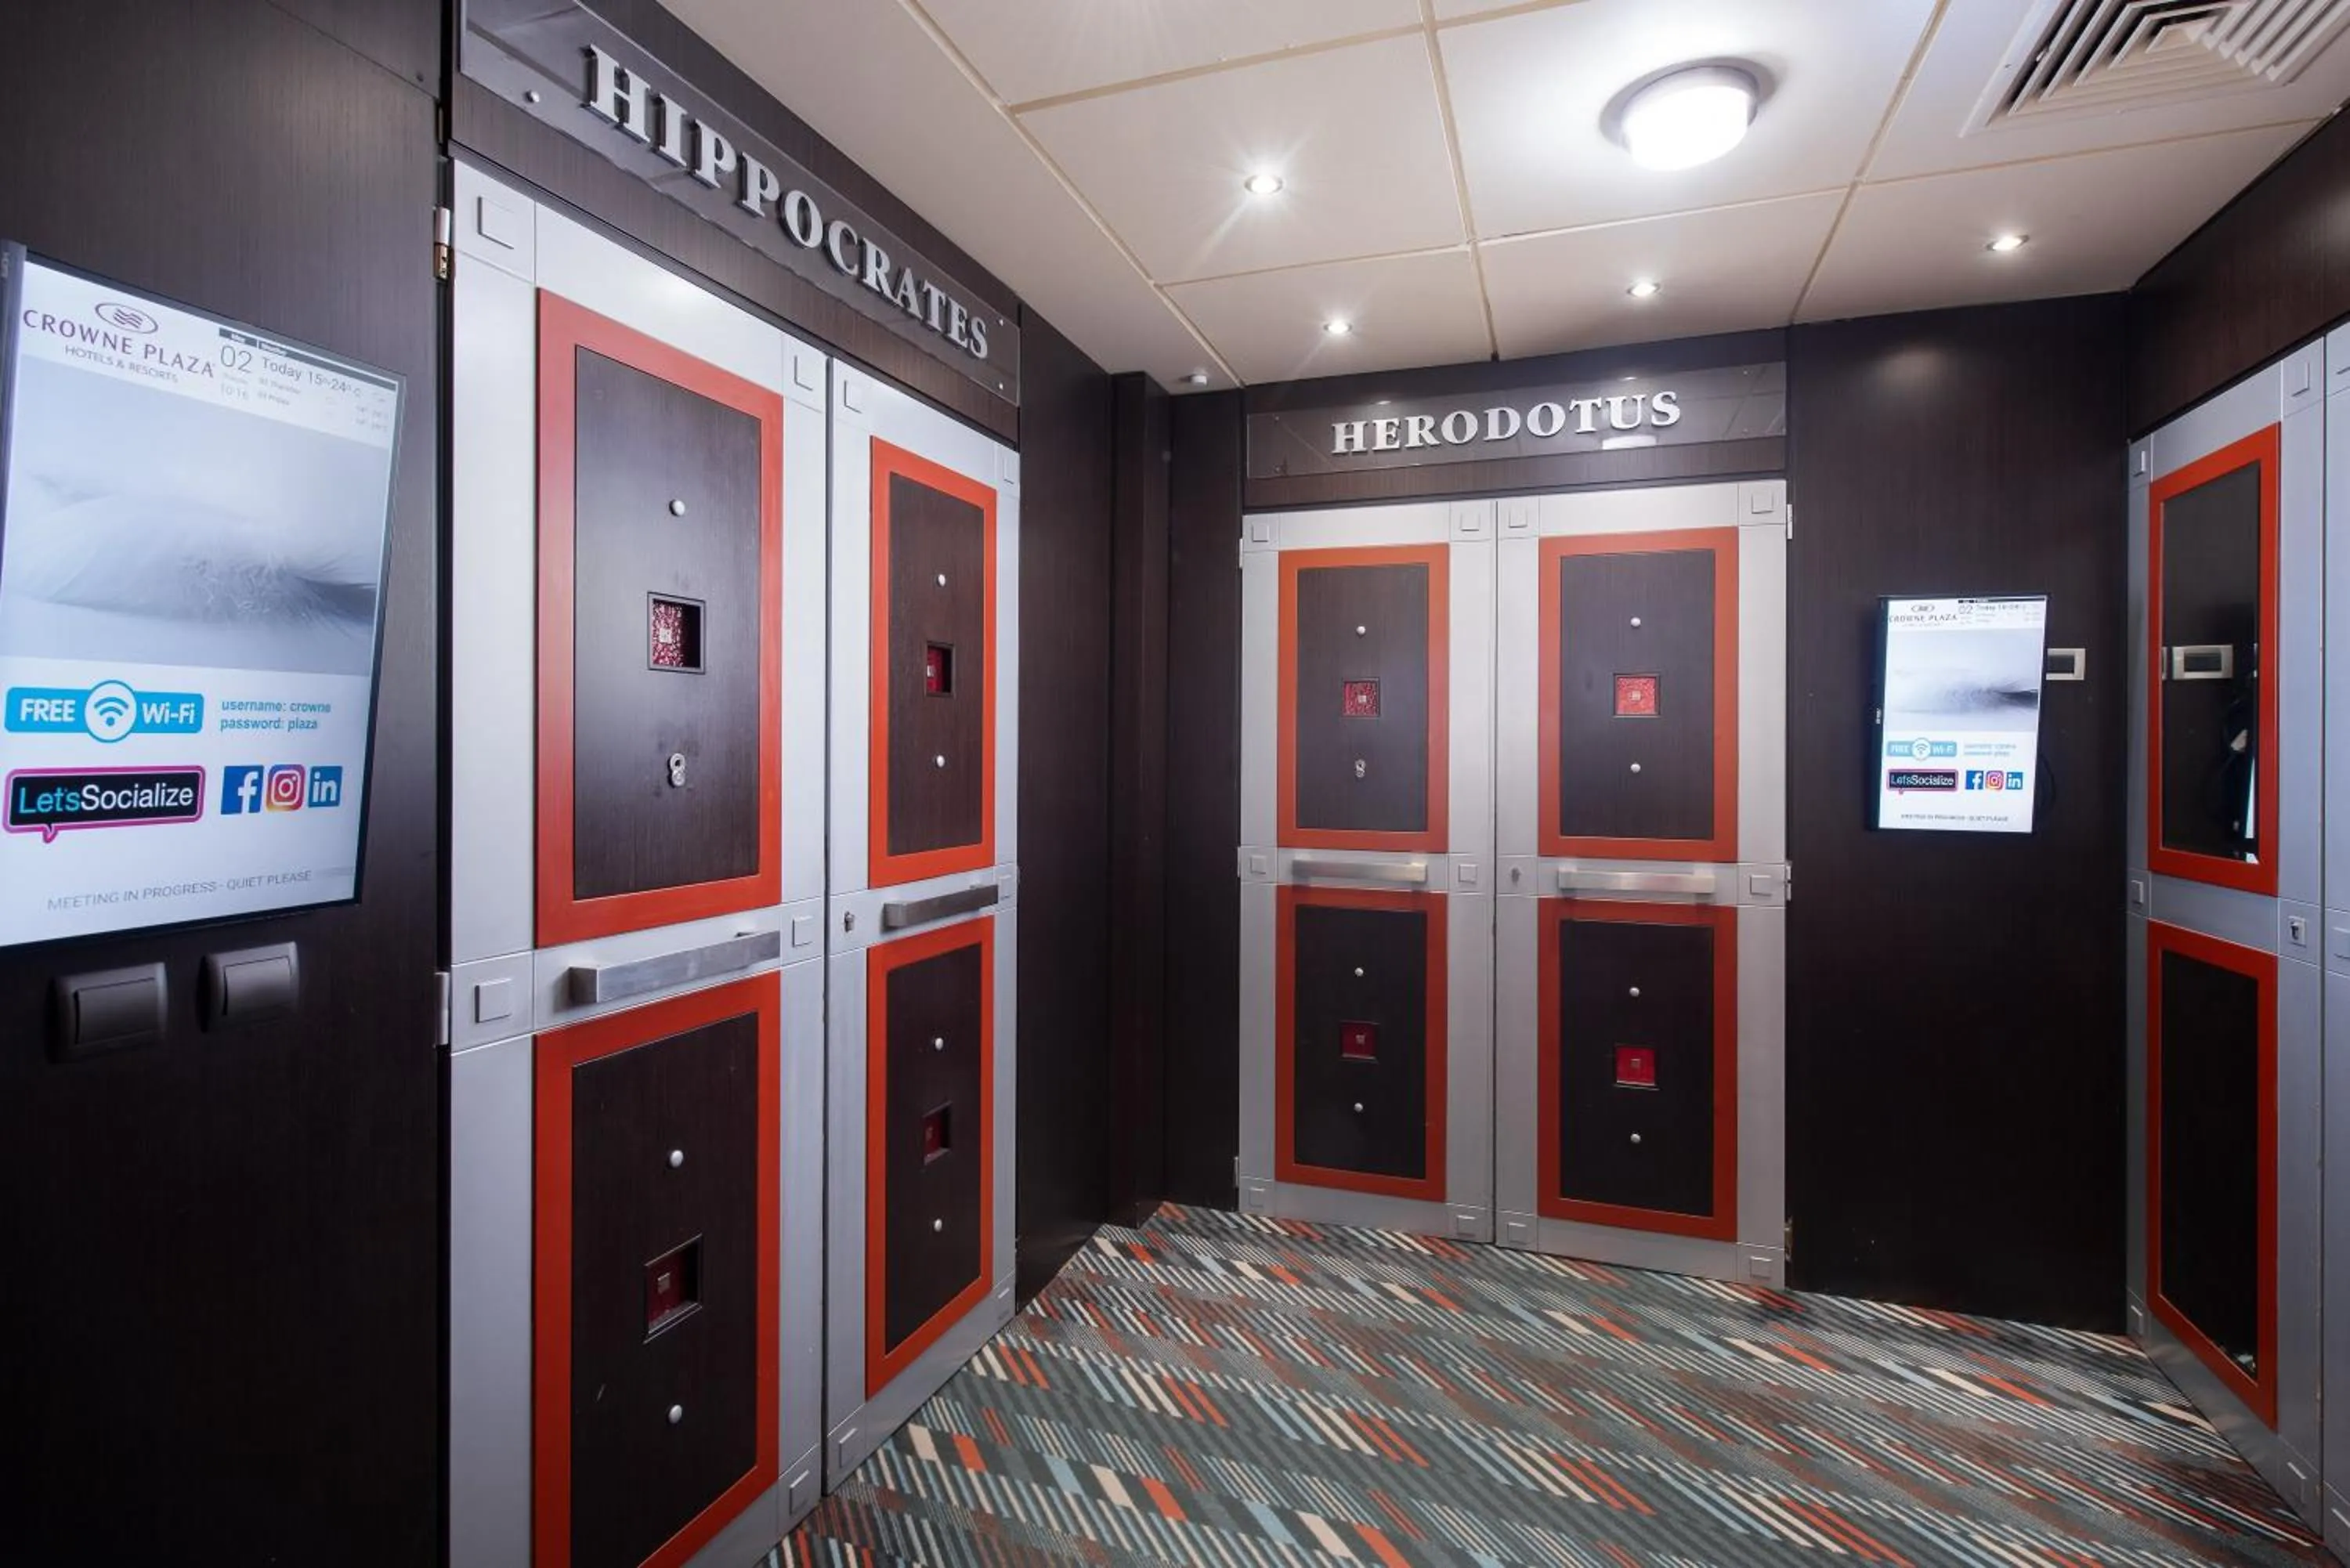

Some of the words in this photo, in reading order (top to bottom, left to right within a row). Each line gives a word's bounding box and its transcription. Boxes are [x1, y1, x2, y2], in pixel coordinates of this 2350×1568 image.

[582, 43, 989, 360] HIPPOCRATES
[23, 309, 132, 356] CROWNE
[143, 343, 215, 378] PLAZA
[220, 345, 253, 374] 02
[65, 345, 114, 367] HOTELS
[128, 363, 178, 384] RESORTS
[262, 356, 302, 381] Today
[1332, 391, 1681, 454] HERODOTUS
[20, 698, 76, 723] FREE
[142, 702, 196, 725] Wi-Fi
[220, 717, 284, 732] password:
[287, 717, 318, 732] plaza
[221, 701, 287, 714] username:
[289, 702, 331, 714] crowne
[47, 891, 119, 910] MEETING
[123, 888, 139, 901] IN
[143, 880, 217, 898] PROGRESS
[226, 876, 264, 891] QUIET
[267, 869, 313, 886] PLEASE
